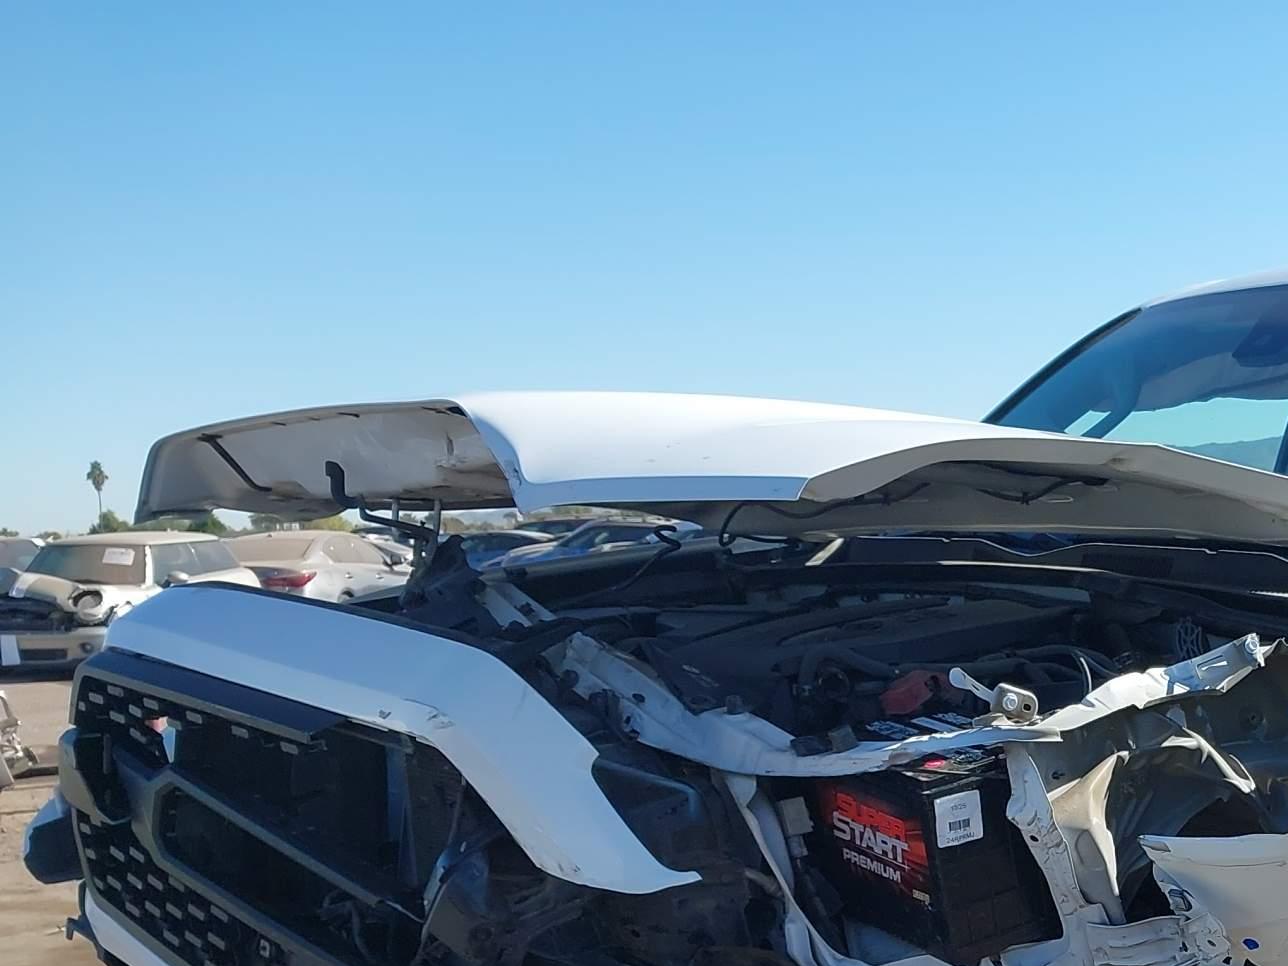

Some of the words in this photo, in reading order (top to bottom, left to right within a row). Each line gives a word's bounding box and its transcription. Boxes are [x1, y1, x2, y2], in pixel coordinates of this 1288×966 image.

[832, 811, 910, 864] START
[836, 793, 906, 842] SUPER
[843, 847, 902, 884] PREMIUM
